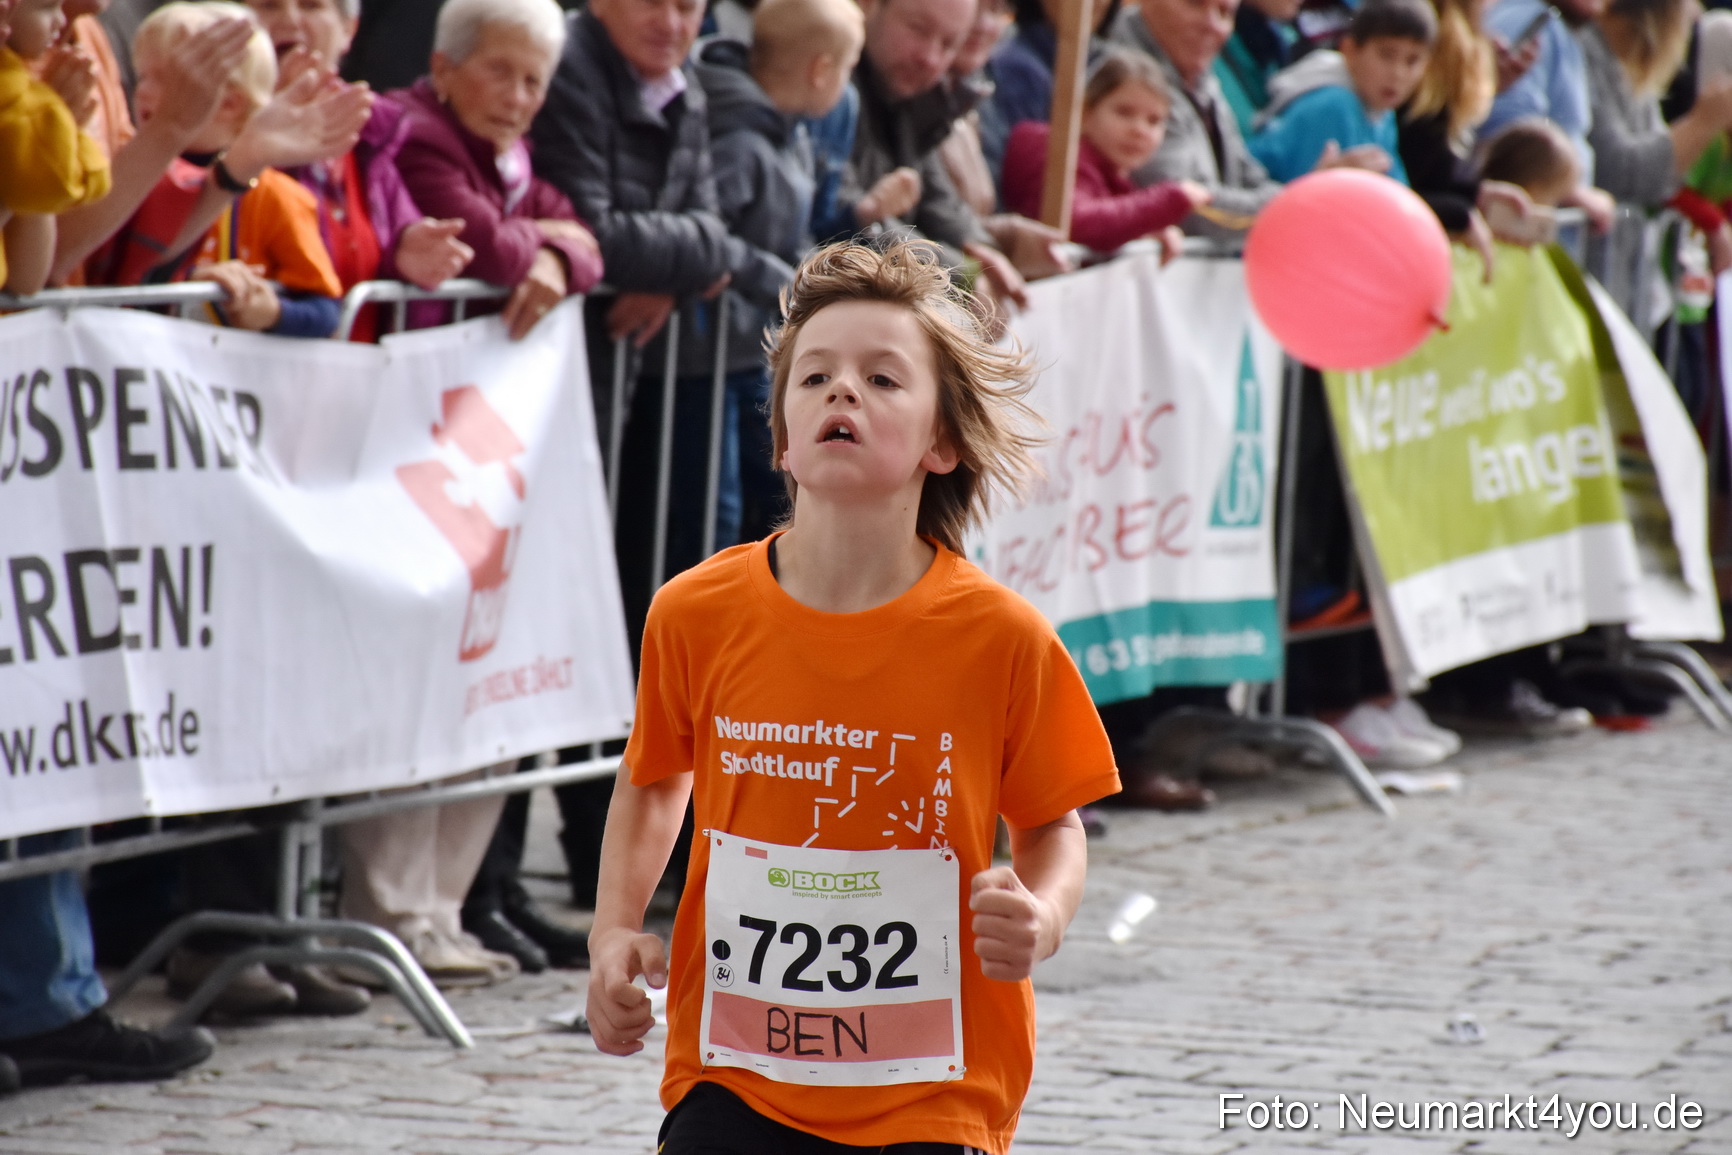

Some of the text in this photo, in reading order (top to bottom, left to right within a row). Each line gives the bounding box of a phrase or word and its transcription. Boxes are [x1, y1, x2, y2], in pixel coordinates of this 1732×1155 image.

[714, 716, 879, 749] Neumarkter
[720, 751, 841, 787] Stadtlauf
[792, 870, 881, 892] BOCK
[792, 890, 819, 899] inspired
[820, 890, 829, 900] by
[852, 890, 882, 899] concepts
[739, 914, 919, 992] 7232
[766, 1006, 868, 1058] BEN
